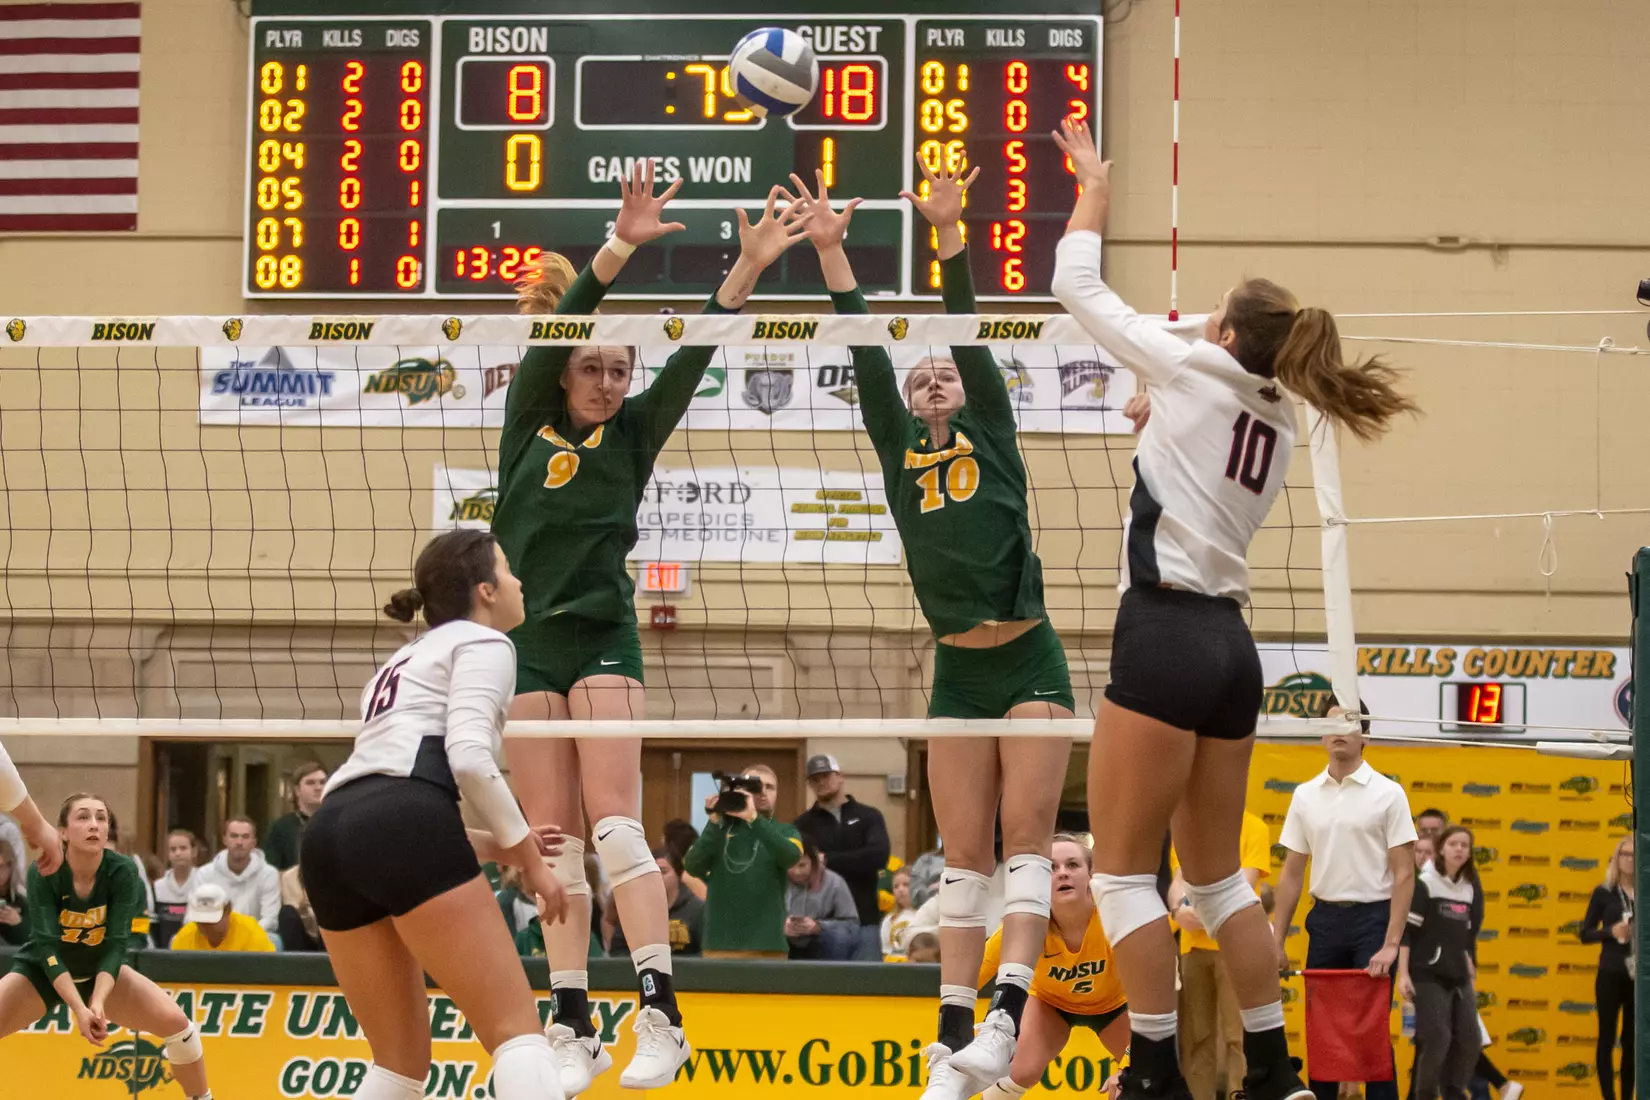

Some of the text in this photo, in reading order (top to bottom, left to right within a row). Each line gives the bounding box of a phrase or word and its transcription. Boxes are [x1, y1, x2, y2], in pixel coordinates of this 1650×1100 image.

[265, 29, 420, 48] PLYR KILLS DIGS
[469, 27, 548, 53] BISON
[926, 28, 1083, 48] PLYR KILLS DIGS
[260, 61, 423, 94] 01 2 0
[508, 65, 542, 121] 8
[823, 65, 874, 121] 18
[921, 61, 1089, 94] 01 0 4
[259, 99, 422, 132] 02 2 0
[920, 98, 968, 133] 05
[1005, 98, 1028, 132] 0
[258, 139, 420, 172] 04 2 0
[506, 133, 541, 191] 0
[588, 156, 752, 183] GAMES WON
[821, 137, 836, 188] 1
[1004, 140, 1027, 173] 5
[257, 176, 421, 210] 05 0 1
[1008, 179, 1026, 212] 3
[256, 217, 420, 250] 07 0 1
[490, 220, 502, 239] 1
[720, 221, 732, 239] 3
[992, 219, 1026, 253] 12
[255, 254, 418, 289] 08 1 0
[1003, 258, 1026, 291] 6
[92, 322, 156, 341] BISON
[309, 321, 375, 341] BISON
[529, 321, 596, 341] BISON
[752, 321, 819, 340] BISON
[976, 321, 1044, 340] BISON
[211, 370, 335, 395] SUMMIT
[363, 371, 438, 395] NDSU
[240, 396, 307, 407] LEAGUE
[1225, 410, 1278, 496] 10
[543, 451, 581, 489] 9
[915, 456, 981, 514] 10
[663, 528, 780, 543] MEDICINE
[647, 563, 680, 589] EXIT
[1356, 646, 1616, 680] KILLS COUNTER
[364, 655, 413, 724] 15
[1468, 683, 1502, 724] 13
[1048, 959, 1106, 983] NDSU
[77, 1056, 159, 1082] NDSU
